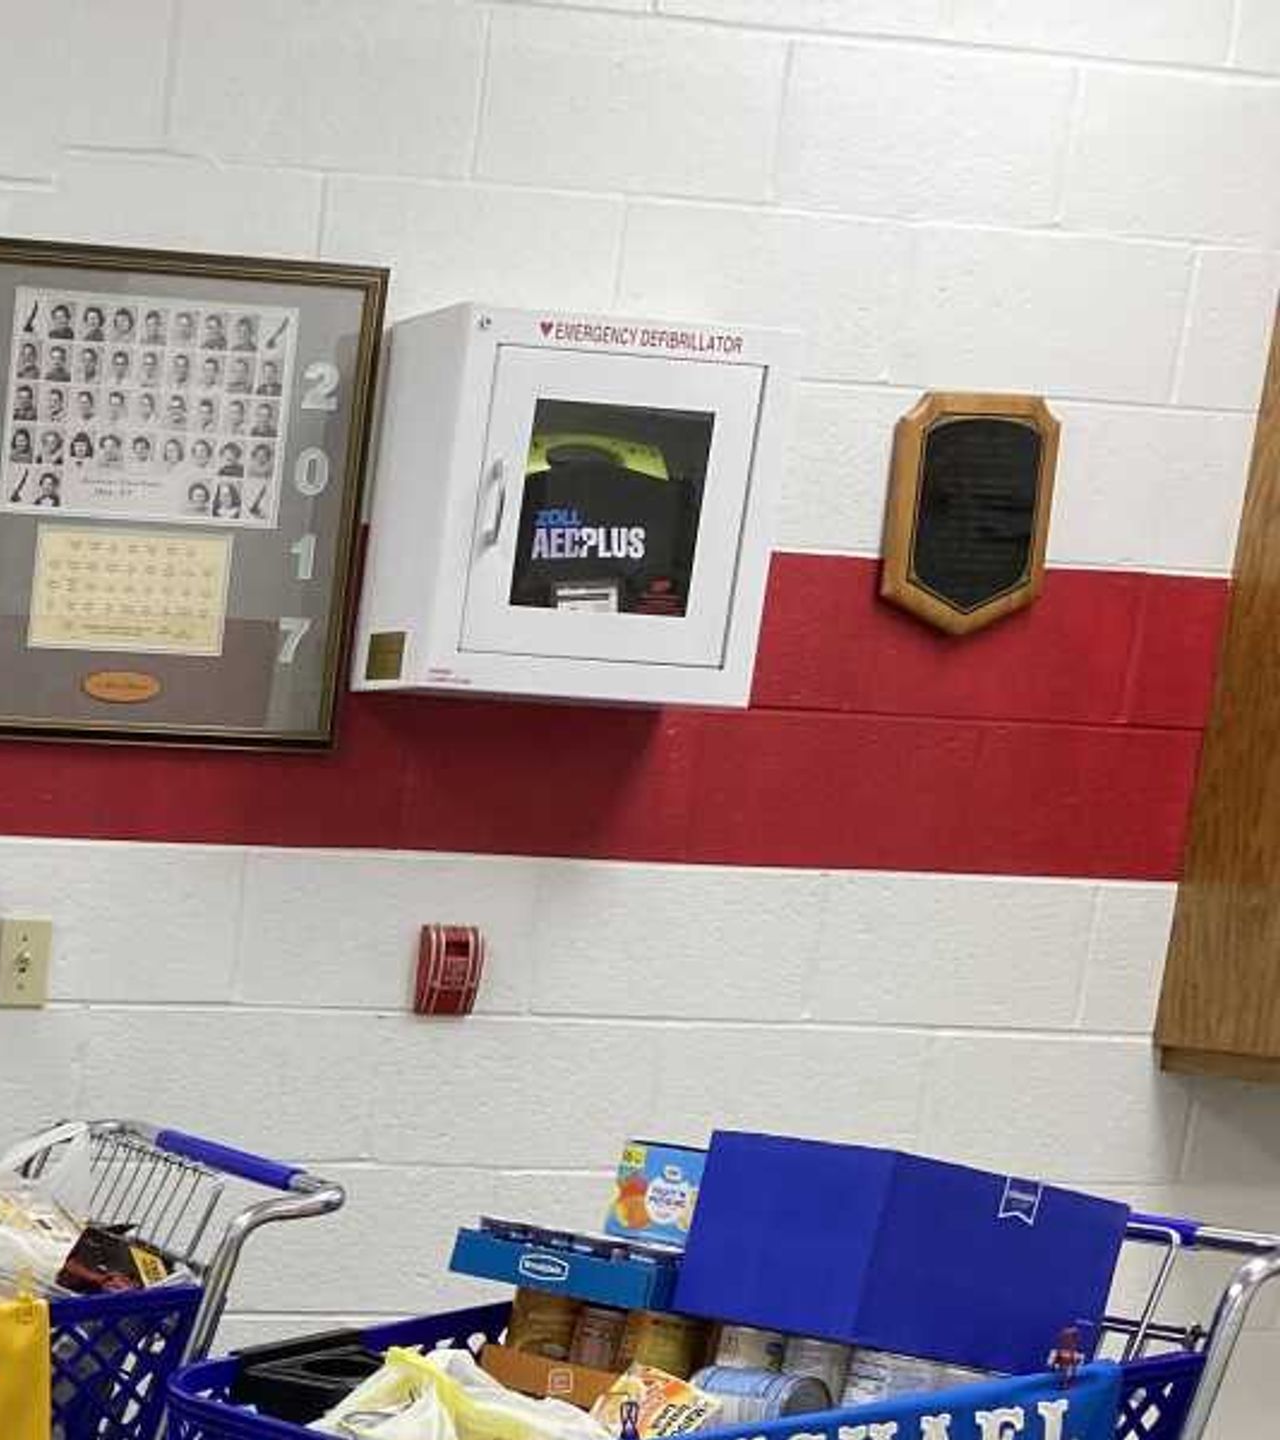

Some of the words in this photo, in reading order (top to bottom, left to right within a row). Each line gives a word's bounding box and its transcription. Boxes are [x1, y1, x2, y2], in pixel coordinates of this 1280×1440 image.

[554, 322, 639, 347] EMERGENCY
[640, 329, 744, 355] DEFIBRILLATOR
[534, 508, 582, 526] ZOLL
